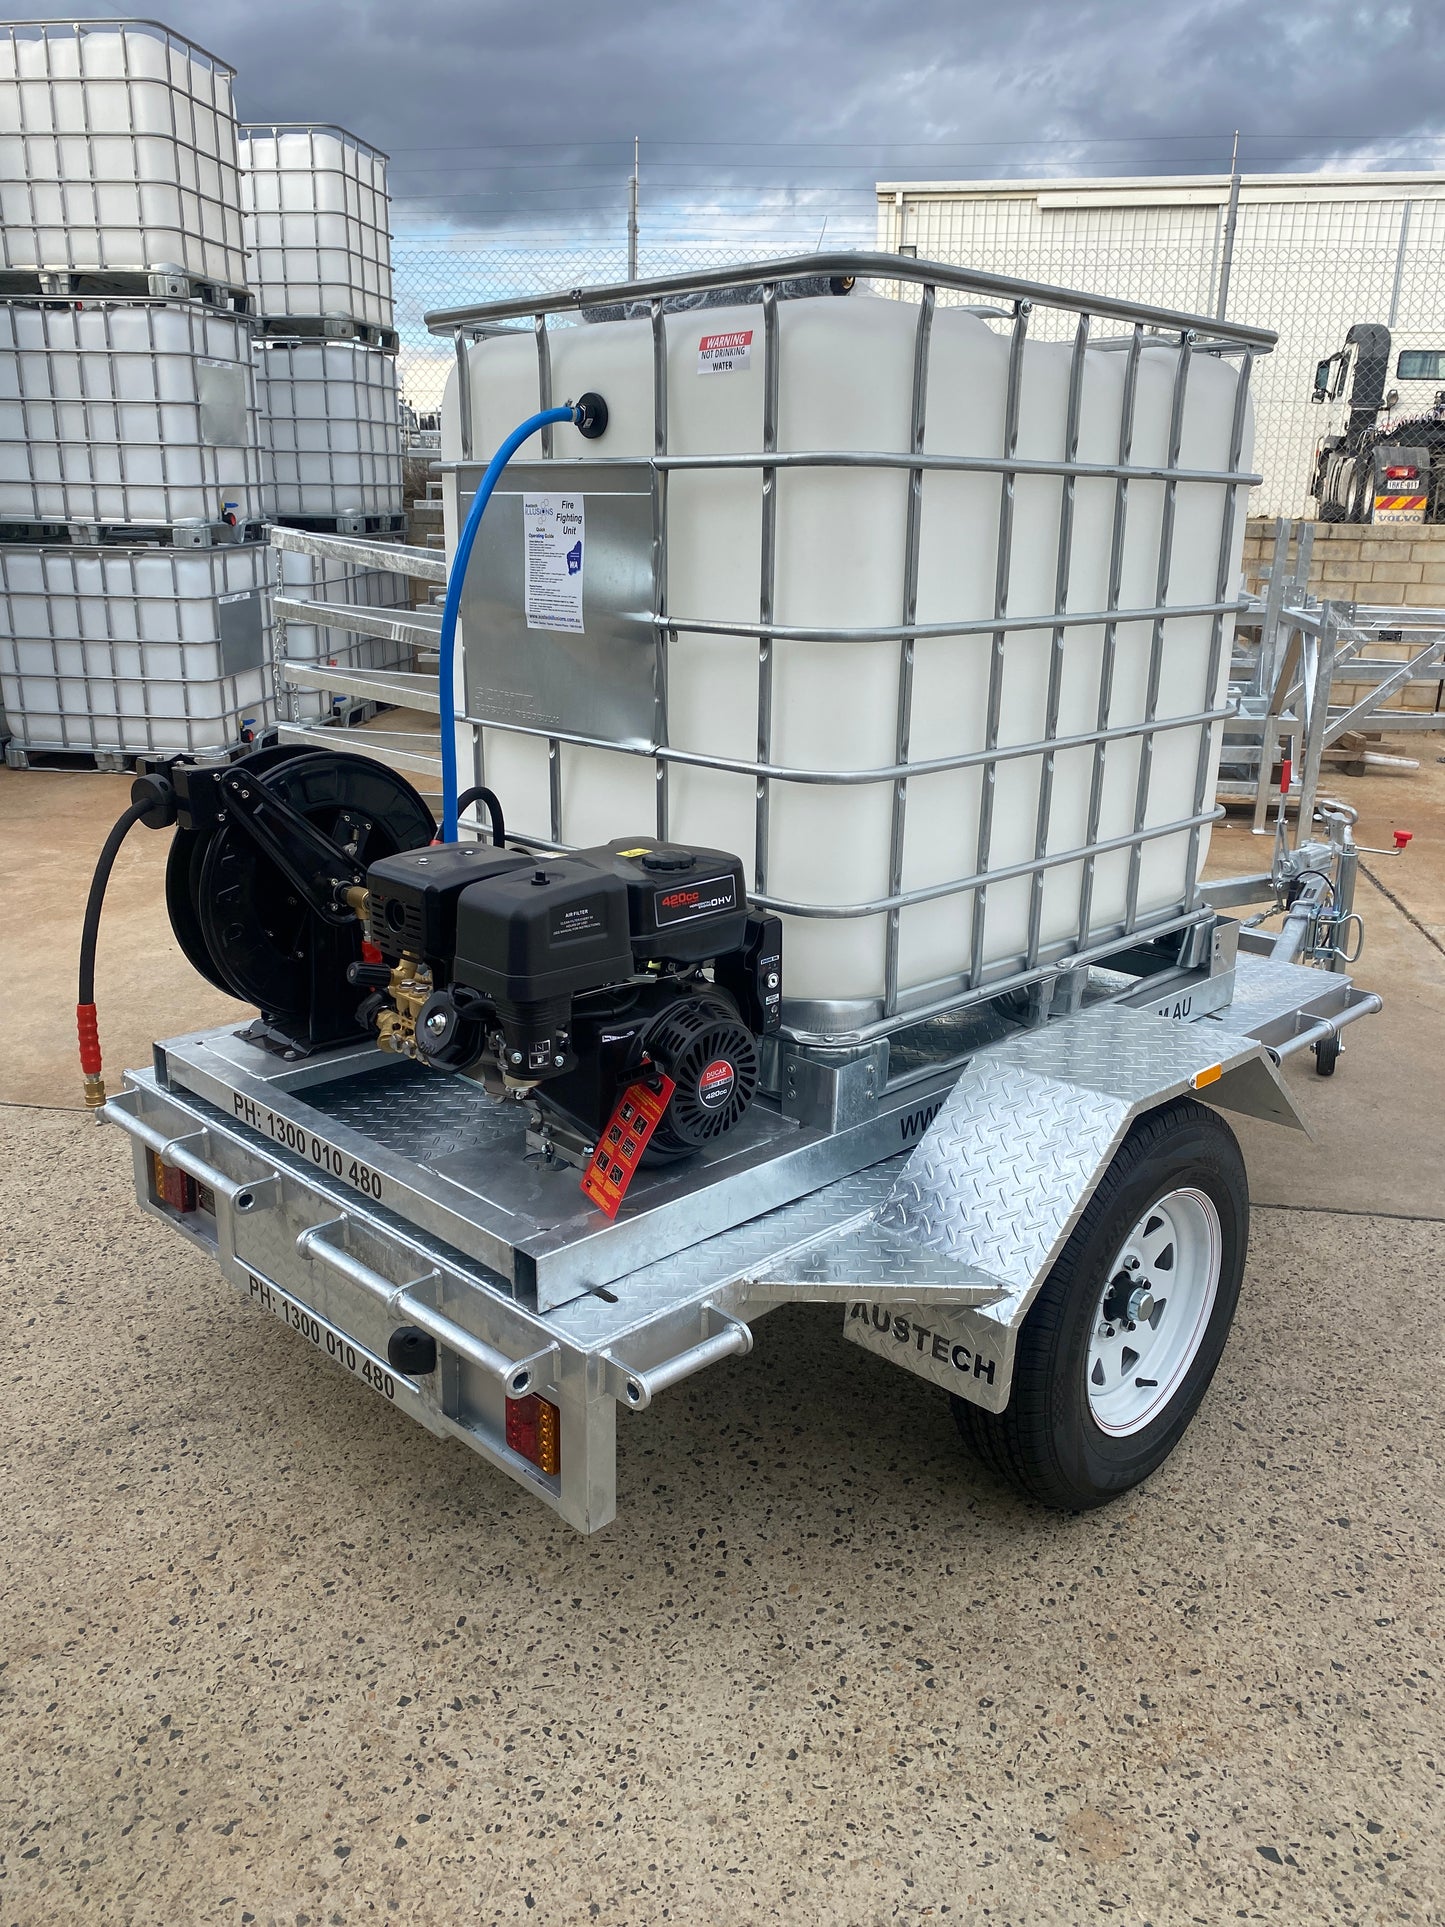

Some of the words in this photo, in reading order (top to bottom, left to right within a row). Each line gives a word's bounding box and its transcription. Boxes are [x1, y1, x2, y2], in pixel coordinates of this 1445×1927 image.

[706, 334, 745, 348] WARNING
[701, 351, 713, 359] NOT
[715, 346, 745, 358] DRINKING
[713, 361, 732, 371] WATER
[562, 501, 574, 509] Fire
[556, 513, 582, 524] Fighting
[563, 526, 576, 534] Unit
[661, 891, 699, 907] 420cc
[711, 894, 732, 906] OHV
[705, 1088, 728, 1100] 420cc
[900, 1102, 943, 1140] WW
[233, 1092, 262, 1129] PH:
[267, 1113, 306, 1155] 1300
[311, 1138, 343, 1177] 010
[348, 1161, 382, 1200] 480
[248, 1274, 277, 1314] PH:
[282, 1300, 320, 1345] 1300
[325, 1330, 356, 1371] 010
[361, 1359, 395, 1400] 480
[850, 1302, 996, 1386] AUSTECH
